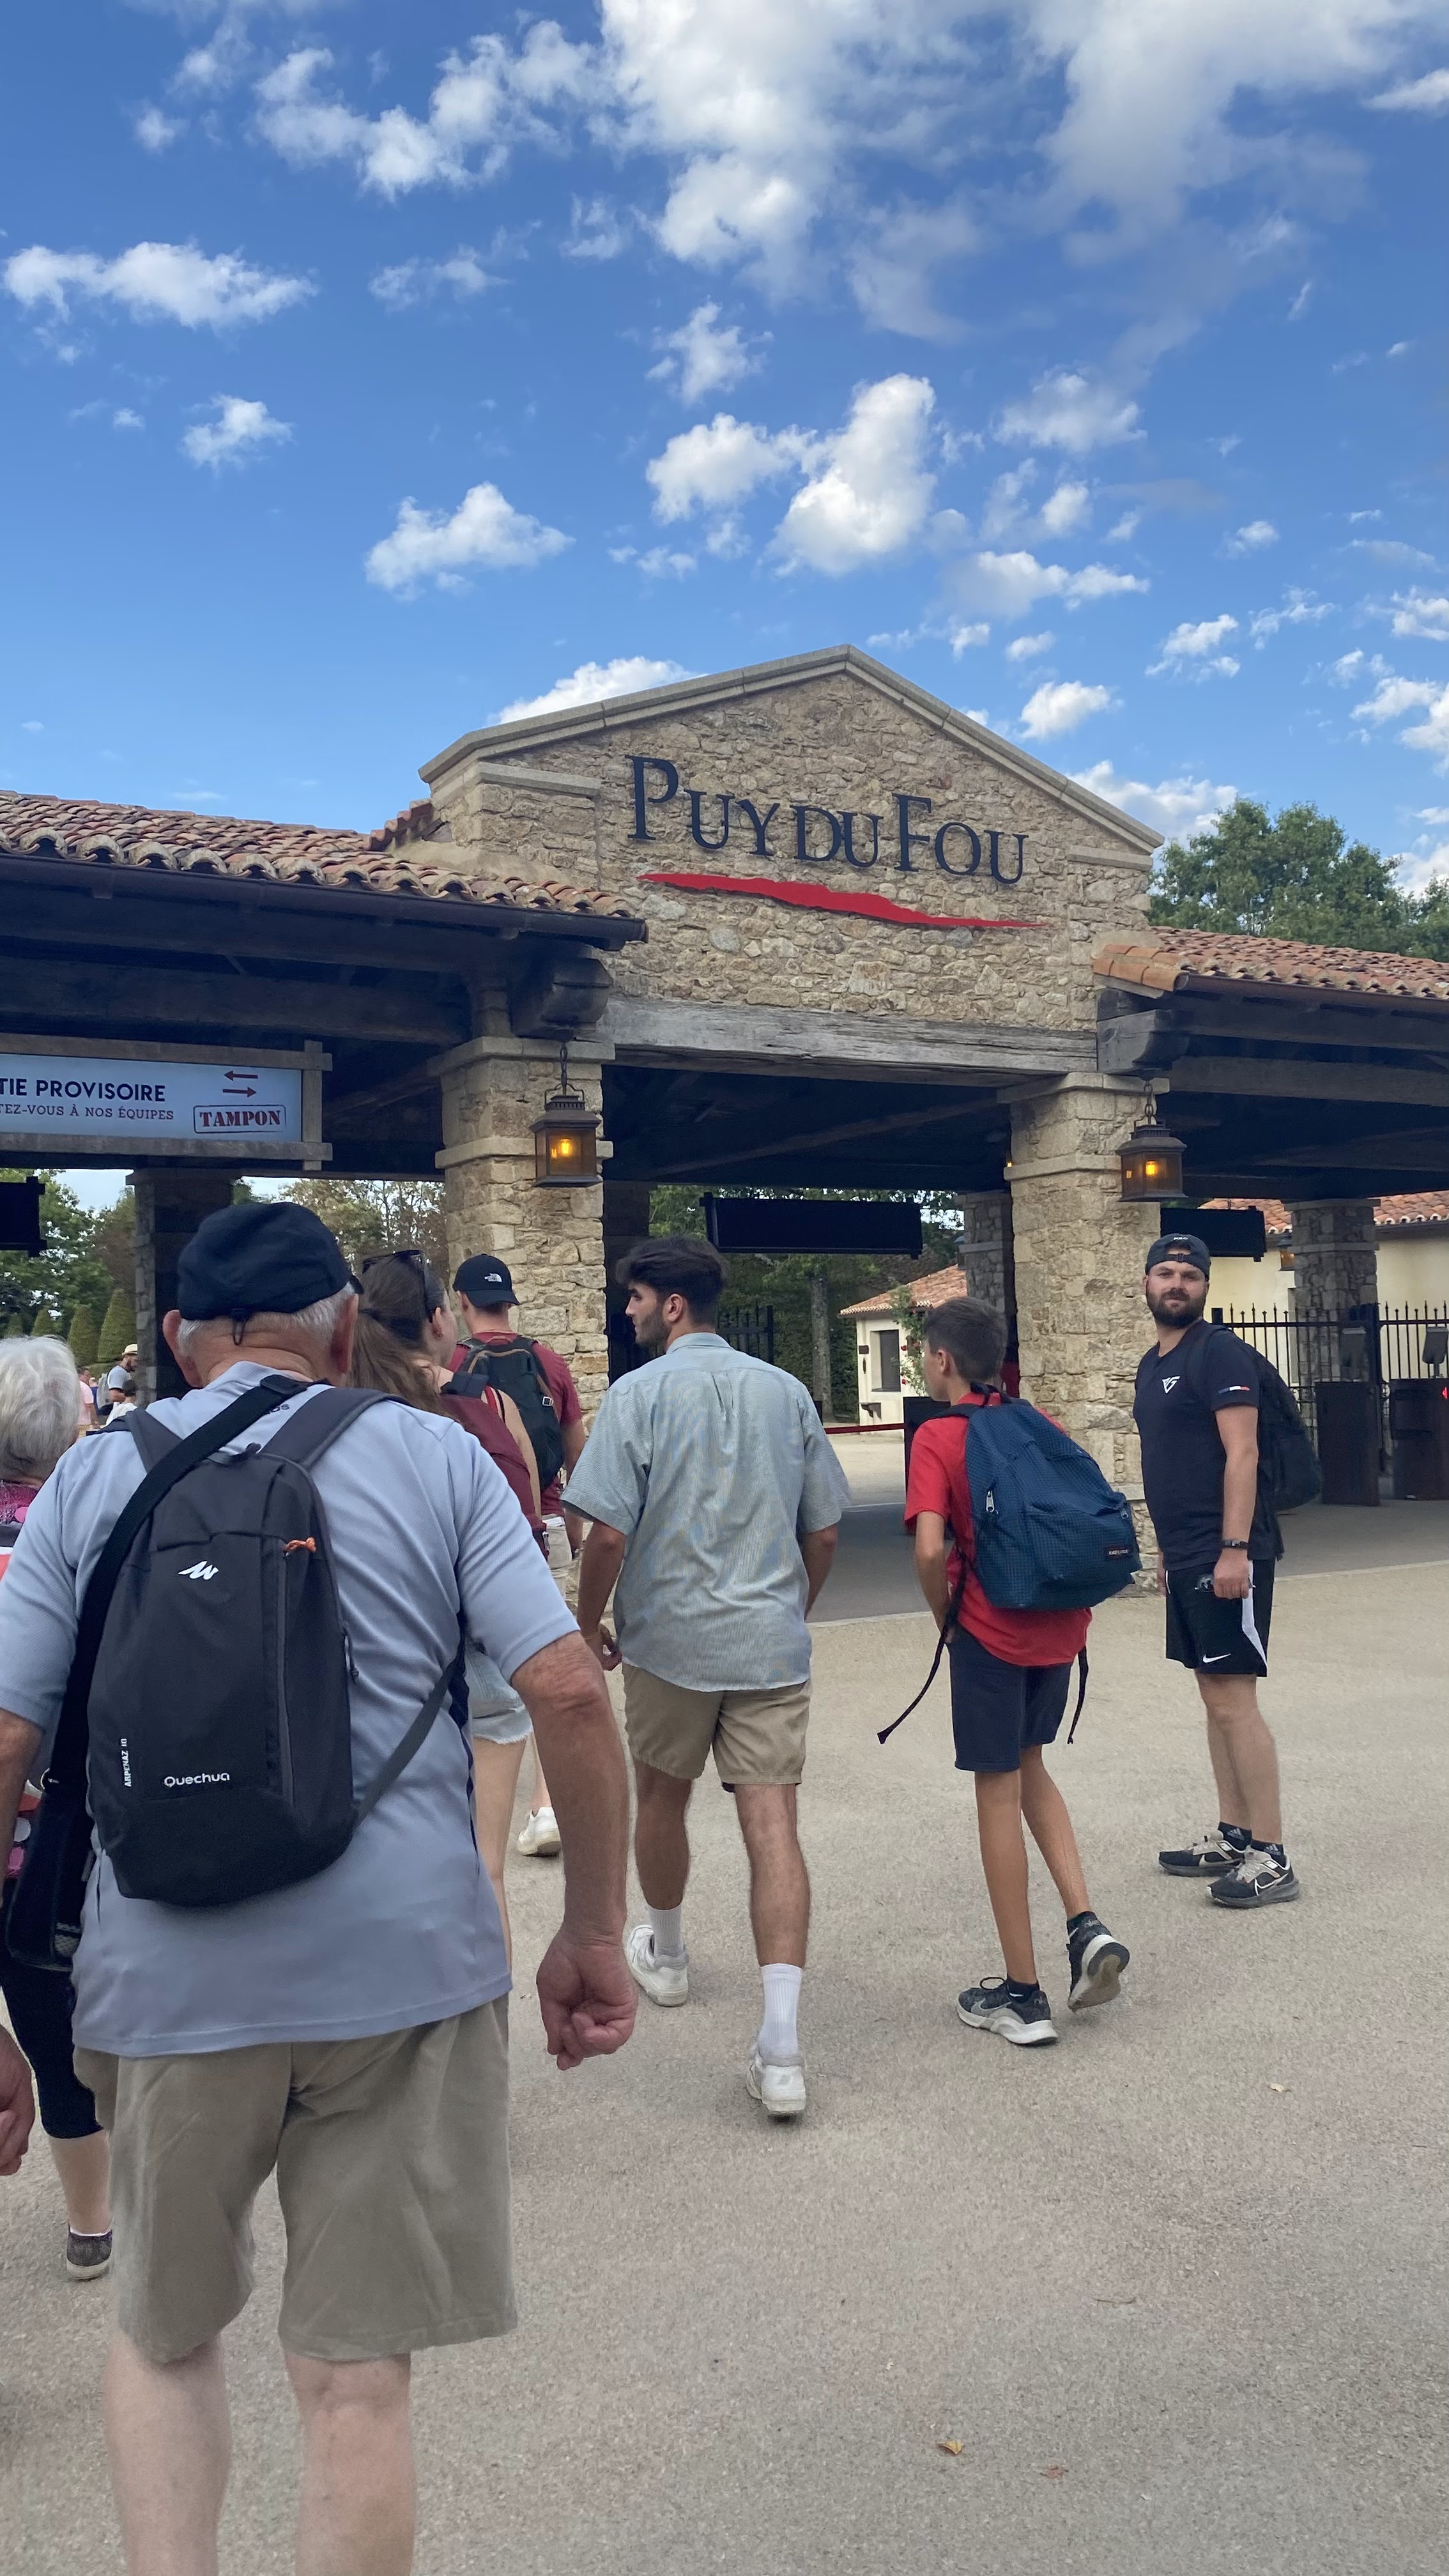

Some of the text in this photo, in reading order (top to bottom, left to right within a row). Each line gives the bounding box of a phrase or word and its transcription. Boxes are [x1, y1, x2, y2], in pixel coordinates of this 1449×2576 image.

[36, 1079, 166, 1102] PROVISOIRE
[70, 1103, 79, 1116] À
[85, 1107, 112, 1117] NOS
[118, 1105, 174, 1120] ÉQUIPES
[199, 1110, 280, 1127] TAMPON
[164, 1772, 230, 1788] Quechua
